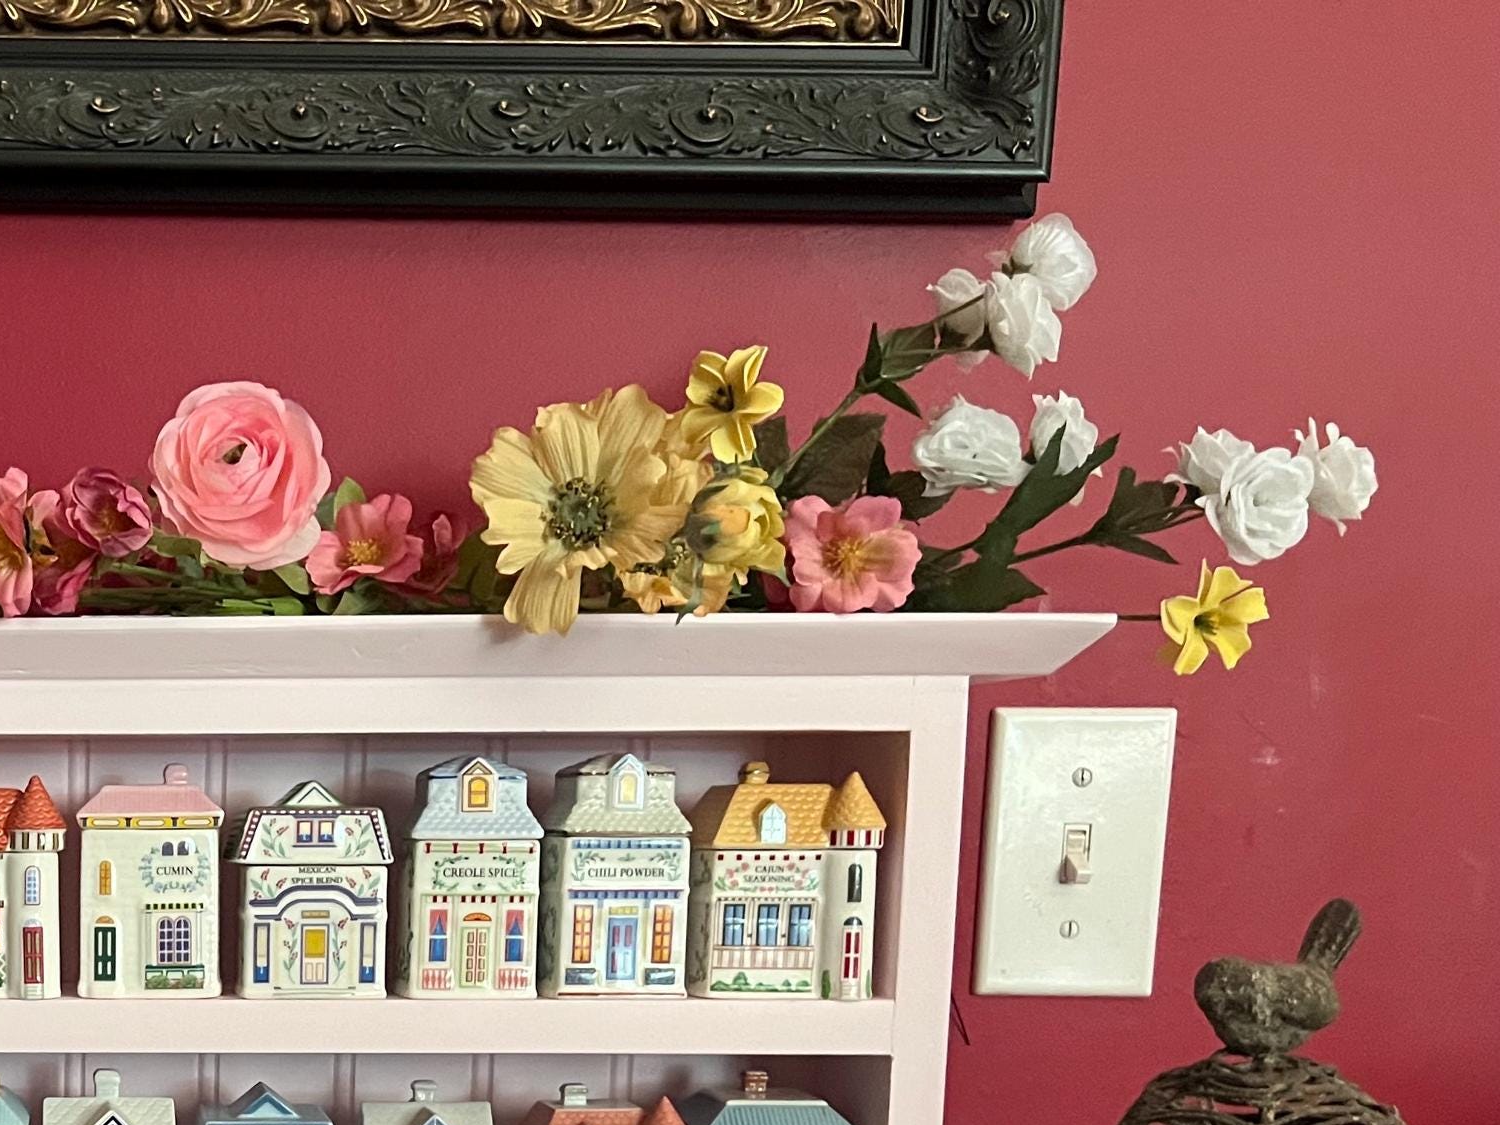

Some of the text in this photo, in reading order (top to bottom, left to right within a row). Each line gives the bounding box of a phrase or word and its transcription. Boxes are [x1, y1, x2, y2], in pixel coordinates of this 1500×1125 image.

[156, 866, 193, 876] CUMIN
[298, 866, 337, 874] MEXICAN
[443, 867, 518, 878] CREOLE SPICE
[587, 867, 665, 878] CHILI POWDER
[755, 865, 785, 874] CAJUN
[291, 876, 343, 885] SPICE BLEND
[743, 875, 795, 883] SEASONING
